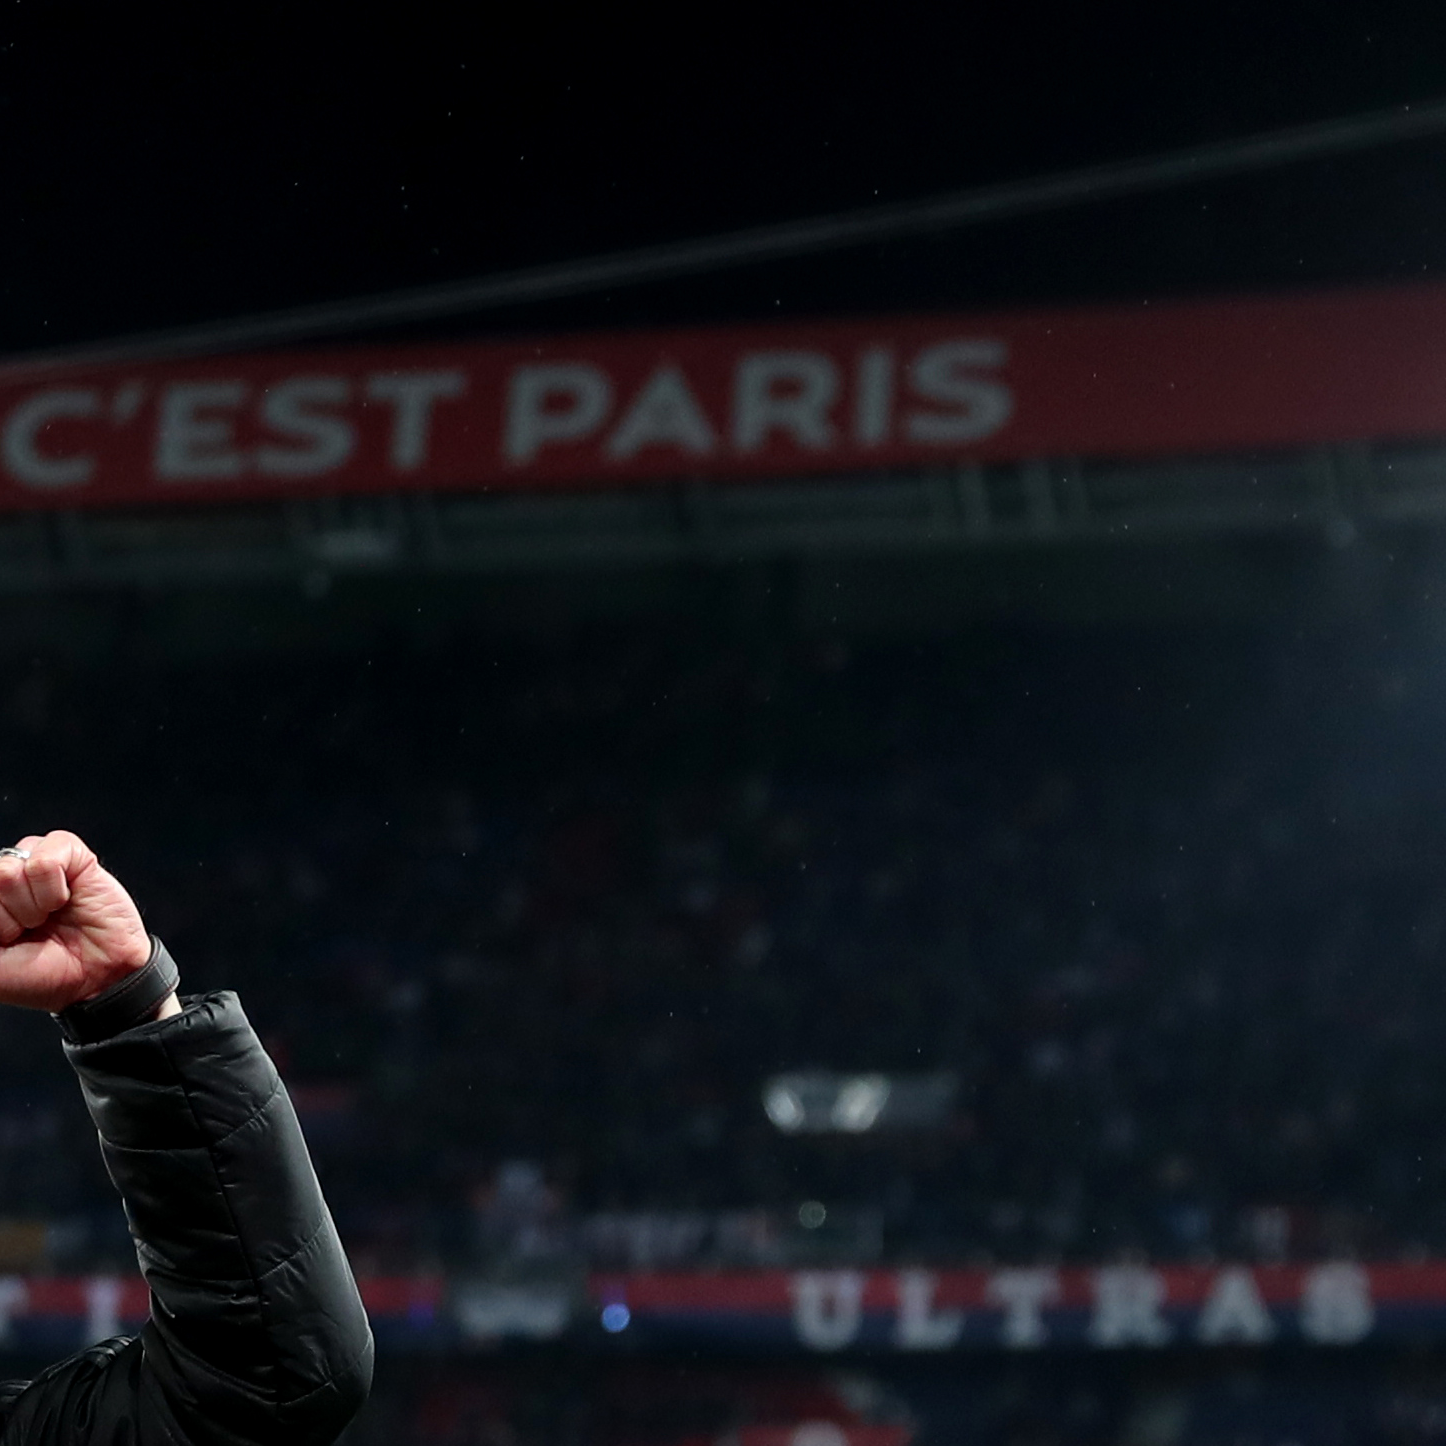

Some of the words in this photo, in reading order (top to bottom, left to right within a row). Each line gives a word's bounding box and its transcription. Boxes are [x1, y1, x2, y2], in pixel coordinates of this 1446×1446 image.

[1, 370, 465, 487] C'EST
[503, 339, 1012, 466] PARIS
[791, 1263, 1373, 1349] ULTRAS
